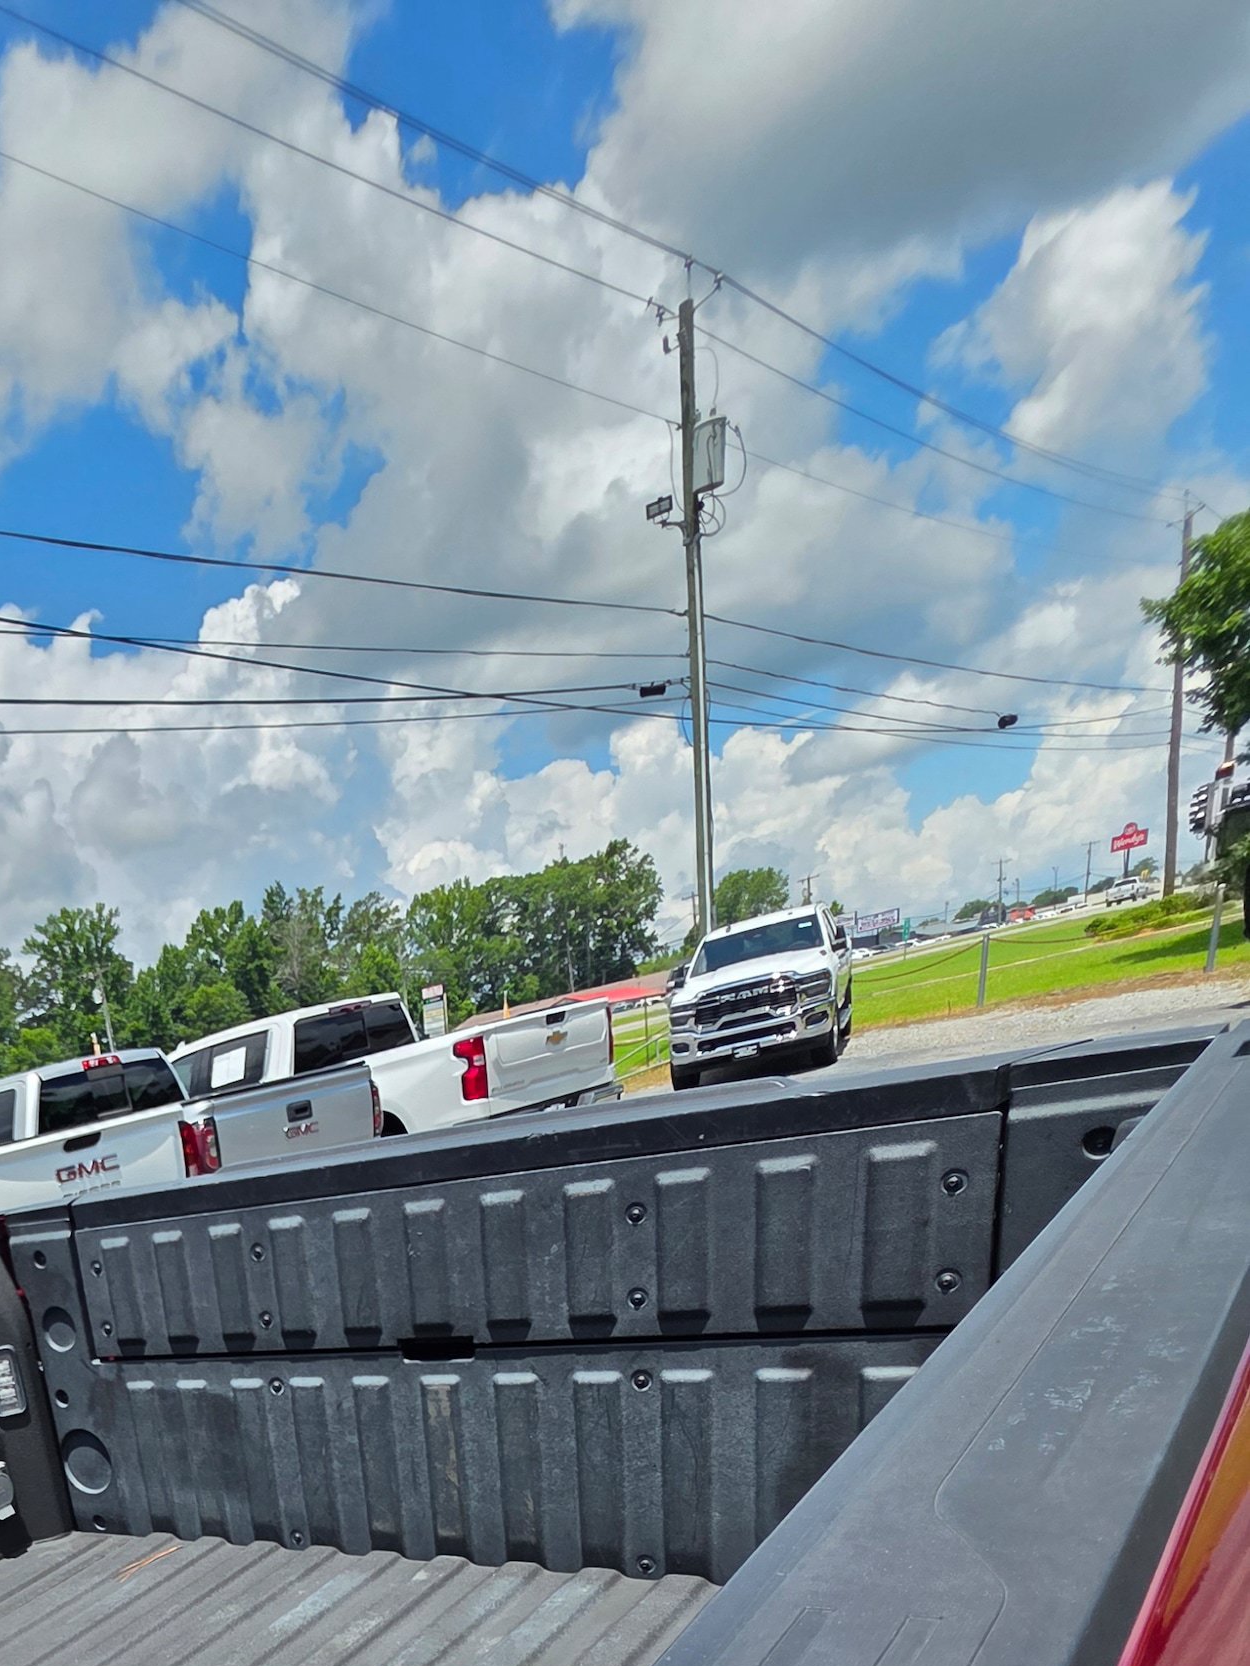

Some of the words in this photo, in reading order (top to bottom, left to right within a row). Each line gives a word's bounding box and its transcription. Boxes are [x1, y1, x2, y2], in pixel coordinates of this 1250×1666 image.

[720, 986, 769, 1003] RAM
[285, 1121, 319, 1140] GMC
[56, 1154, 120, 1184] GMC
